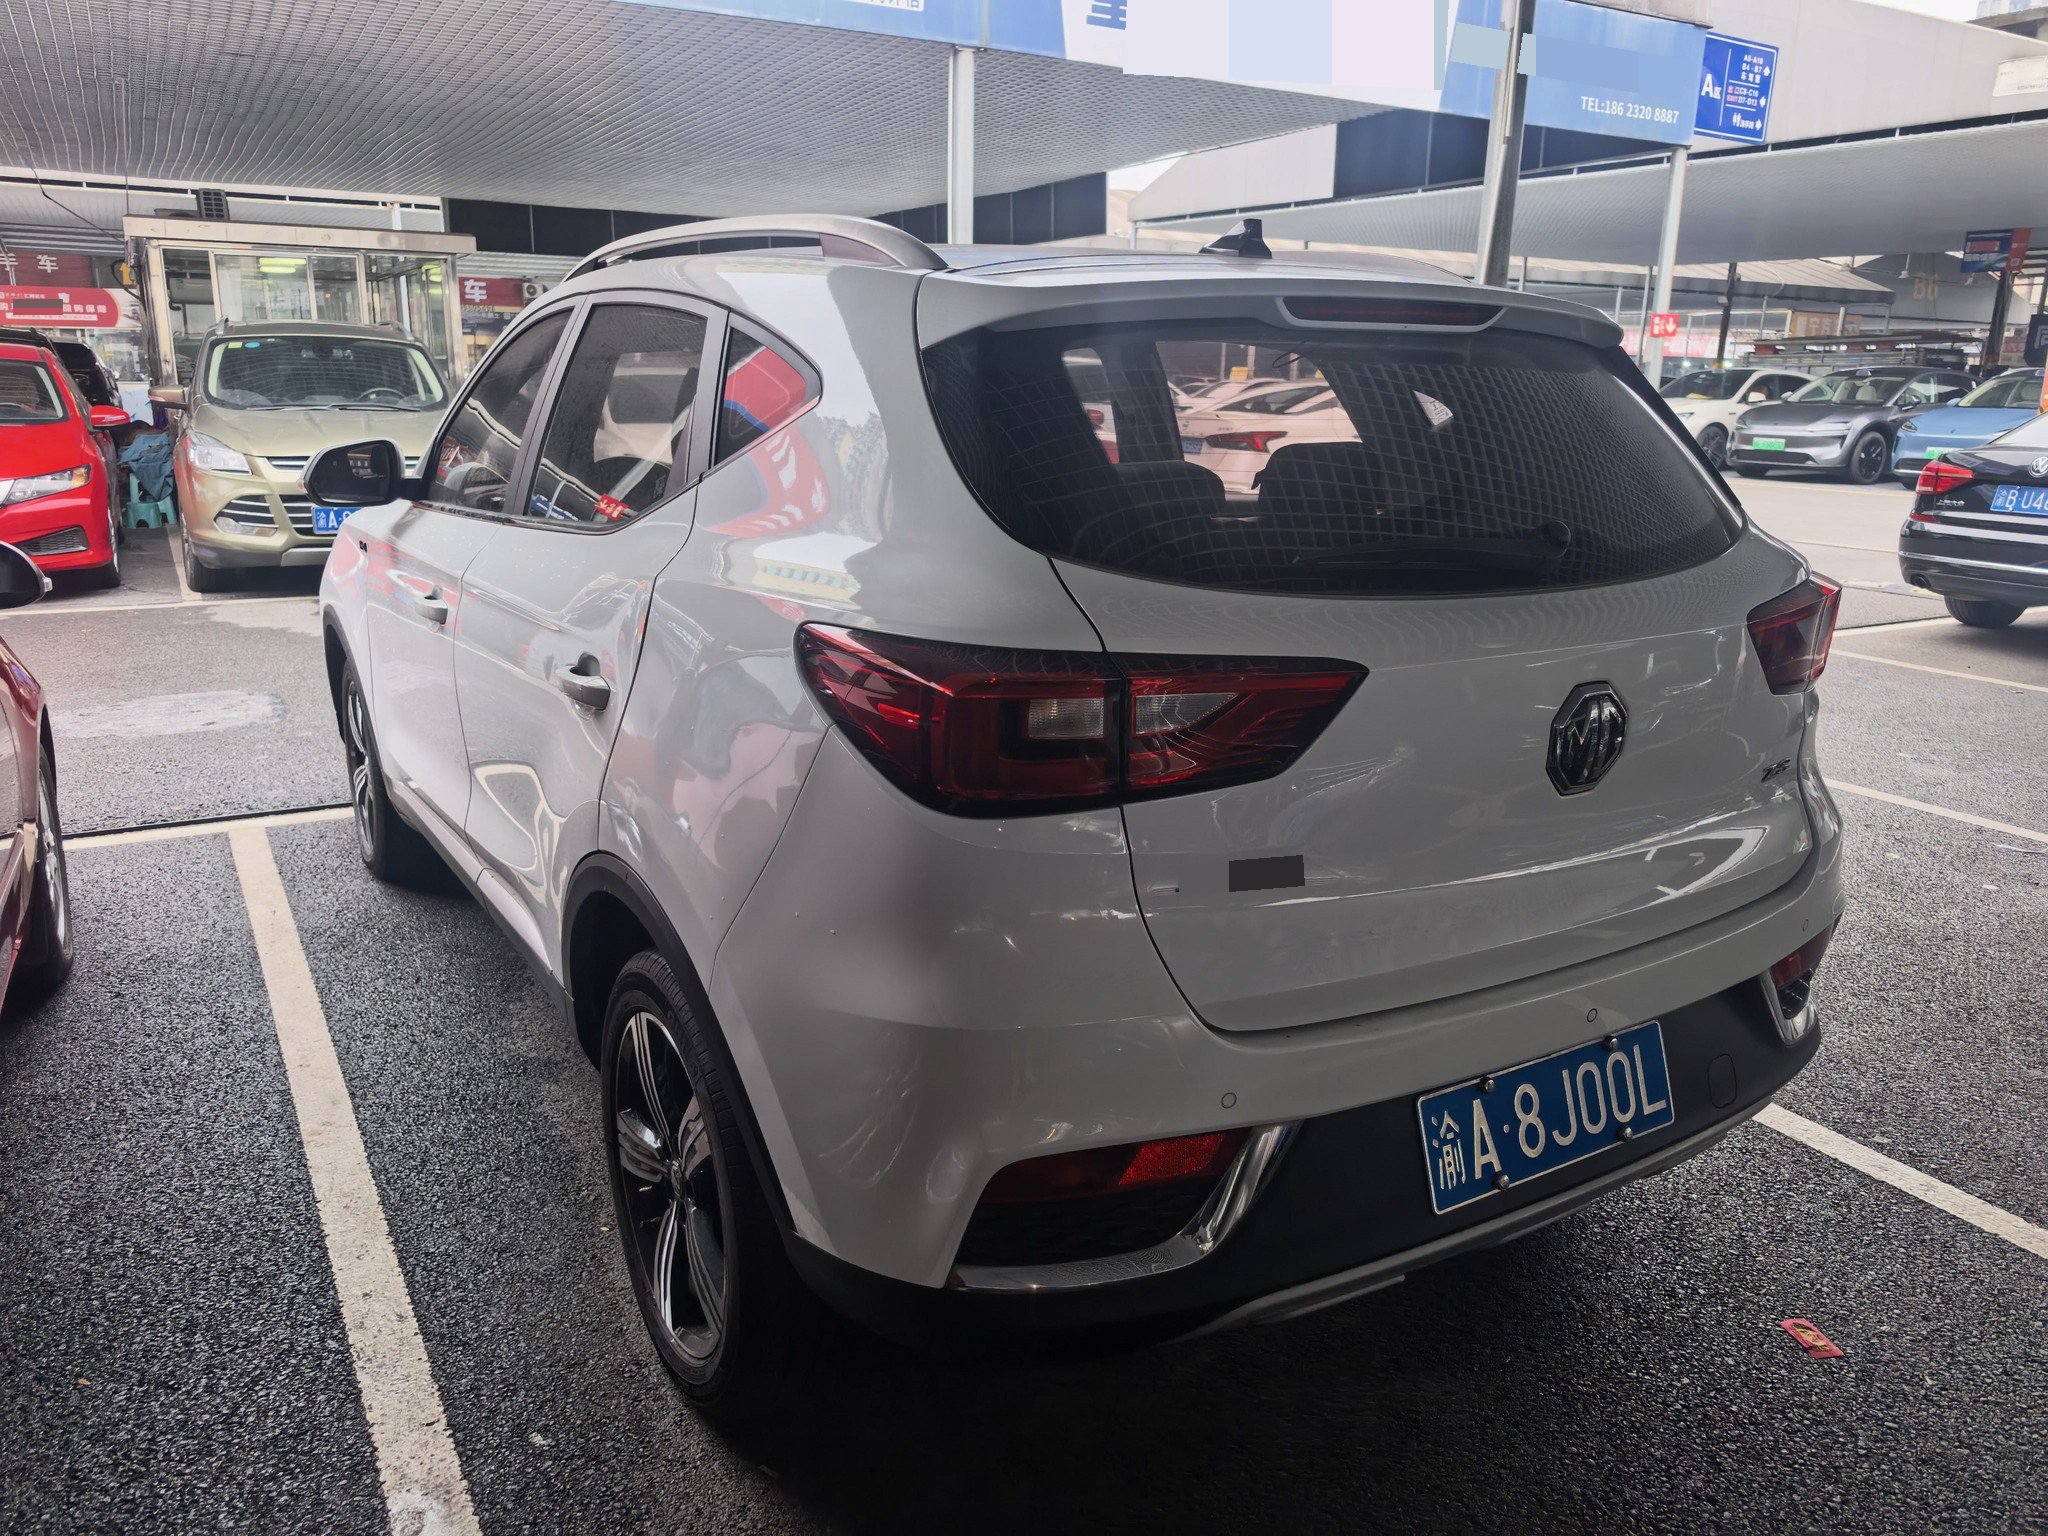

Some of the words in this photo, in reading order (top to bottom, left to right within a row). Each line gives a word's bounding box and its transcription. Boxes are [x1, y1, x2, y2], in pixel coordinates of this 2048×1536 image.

[1580, 95, 1625, 116] TEL:186
[1626, 103, 1652, 120] 2320
[1654, 107, 1680, 124] 8887
[464, 279, 488, 303] 车
